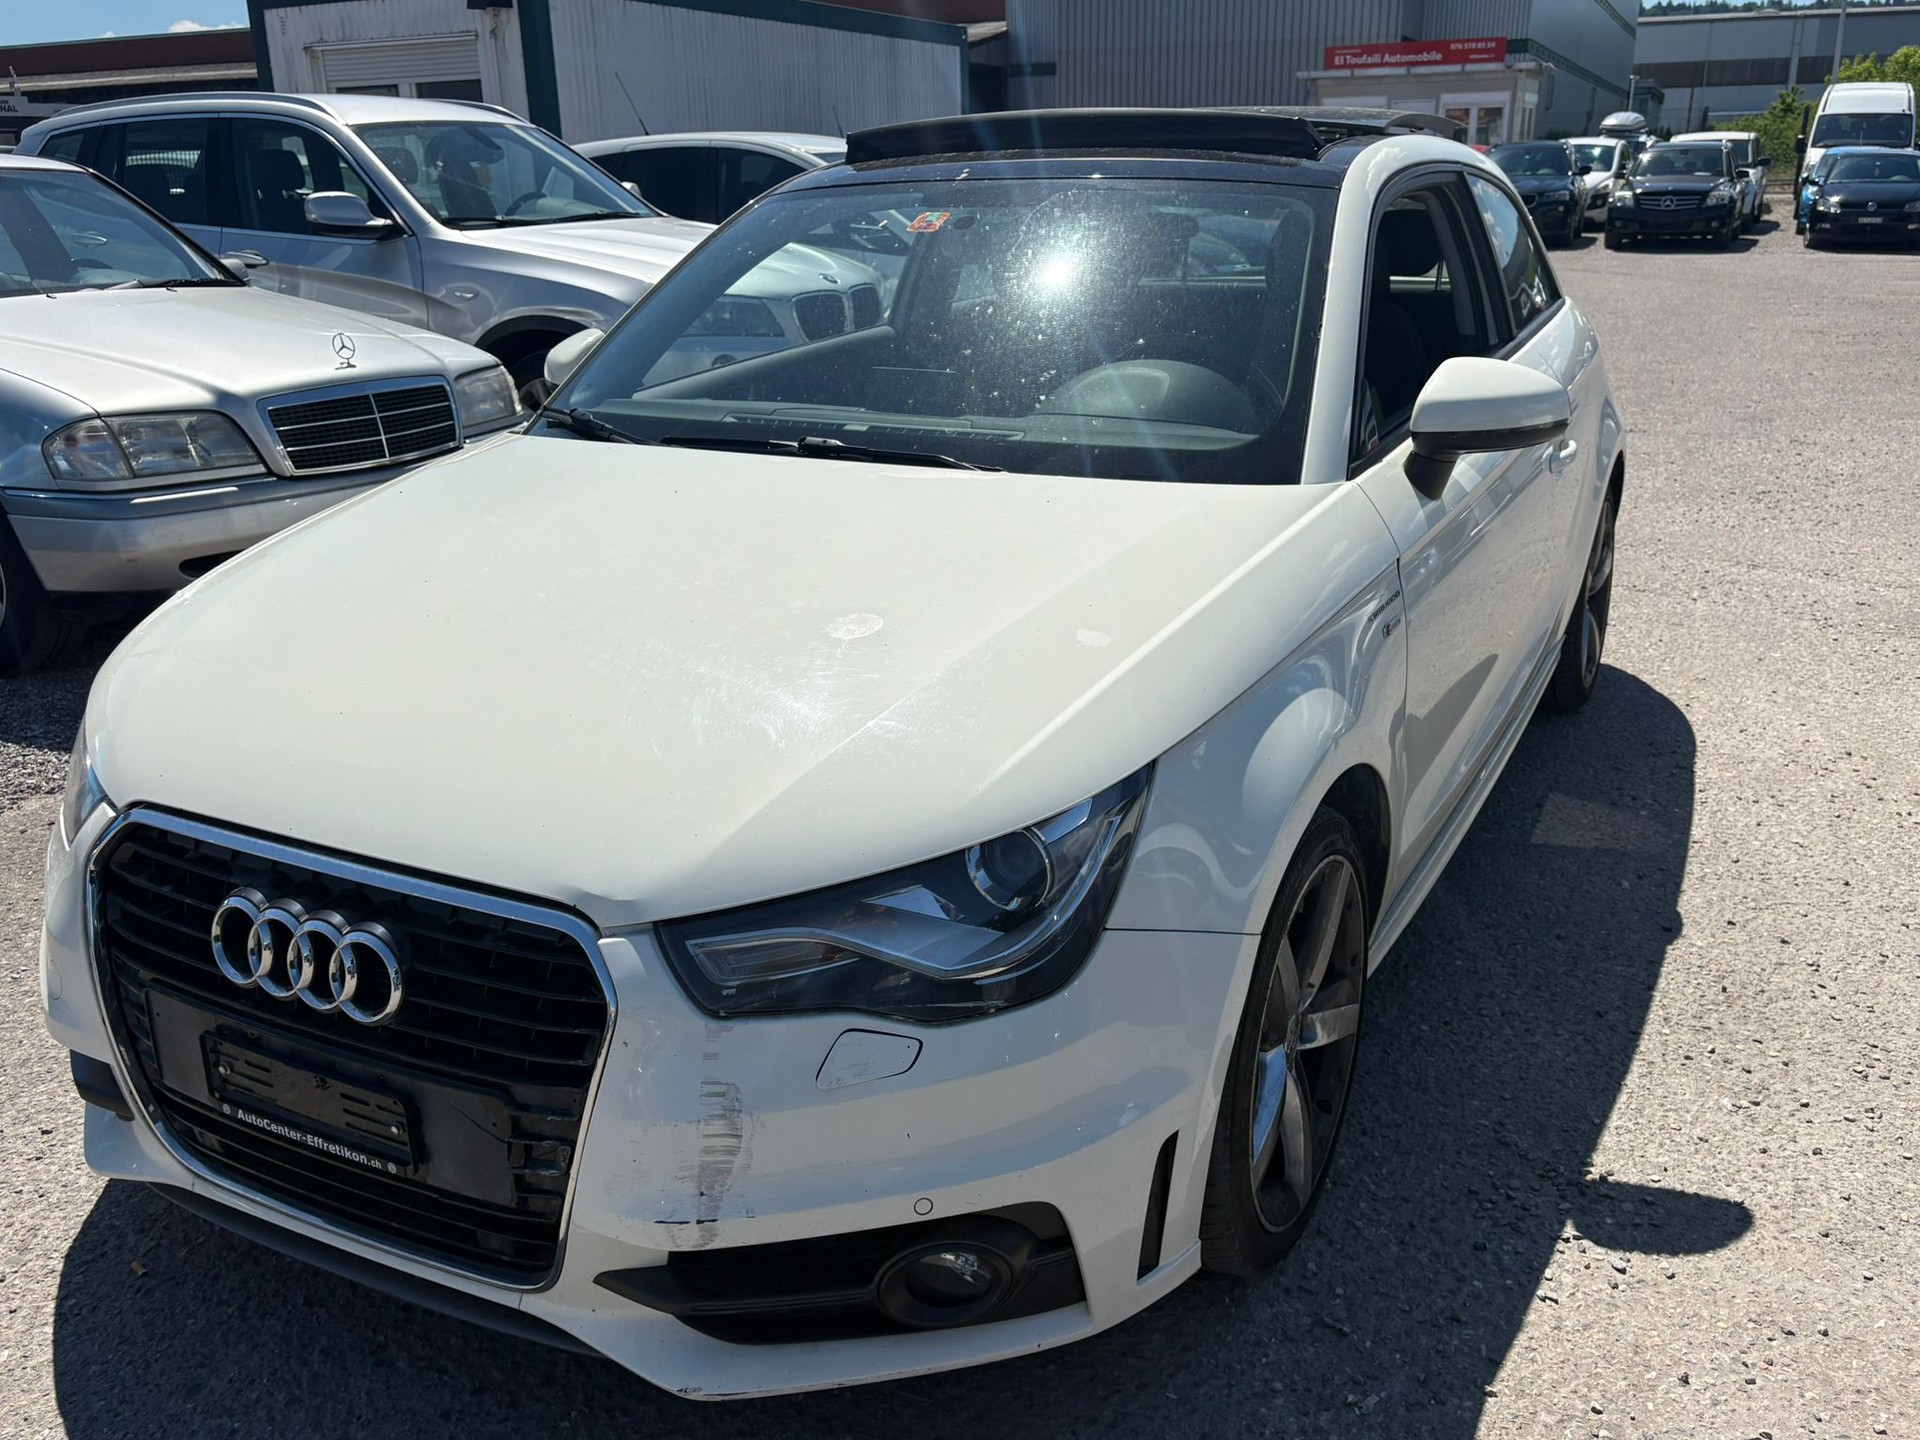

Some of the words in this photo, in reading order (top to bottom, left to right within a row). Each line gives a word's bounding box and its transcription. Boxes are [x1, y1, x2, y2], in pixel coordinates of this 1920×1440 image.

[1334, 55, 1344, 65] El
[1383, 51, 1442, 63] Automobile
[237, 1109, 382, 1170] AutoCenter-Effretikon.ch
